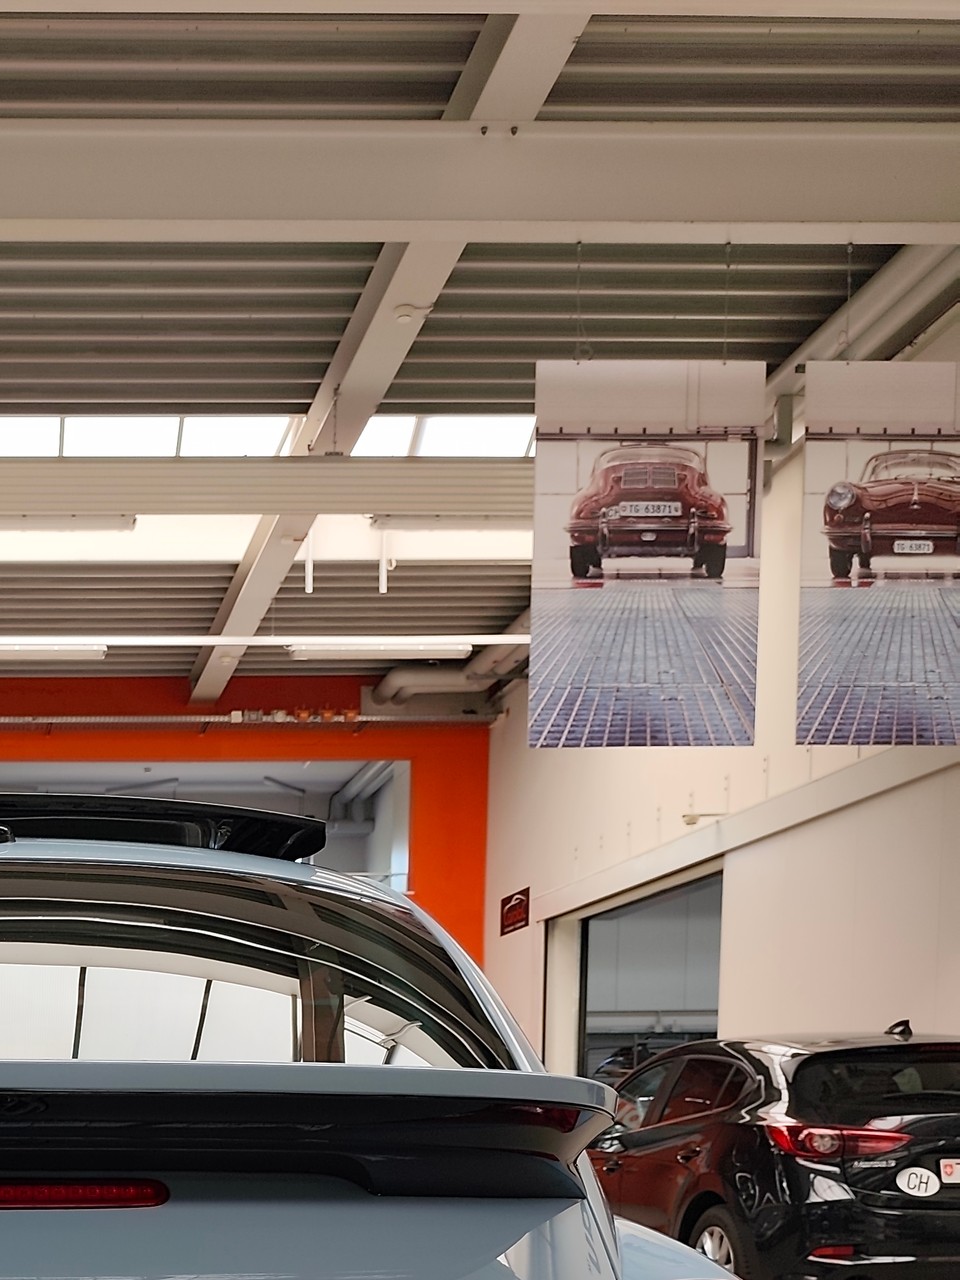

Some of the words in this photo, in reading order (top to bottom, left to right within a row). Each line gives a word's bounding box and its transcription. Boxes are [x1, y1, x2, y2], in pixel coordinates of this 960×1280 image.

[629, 504, 640, 514] TG
[644, 504, 672, 514] 63871
[907, 1172, 930, 1193] CH
